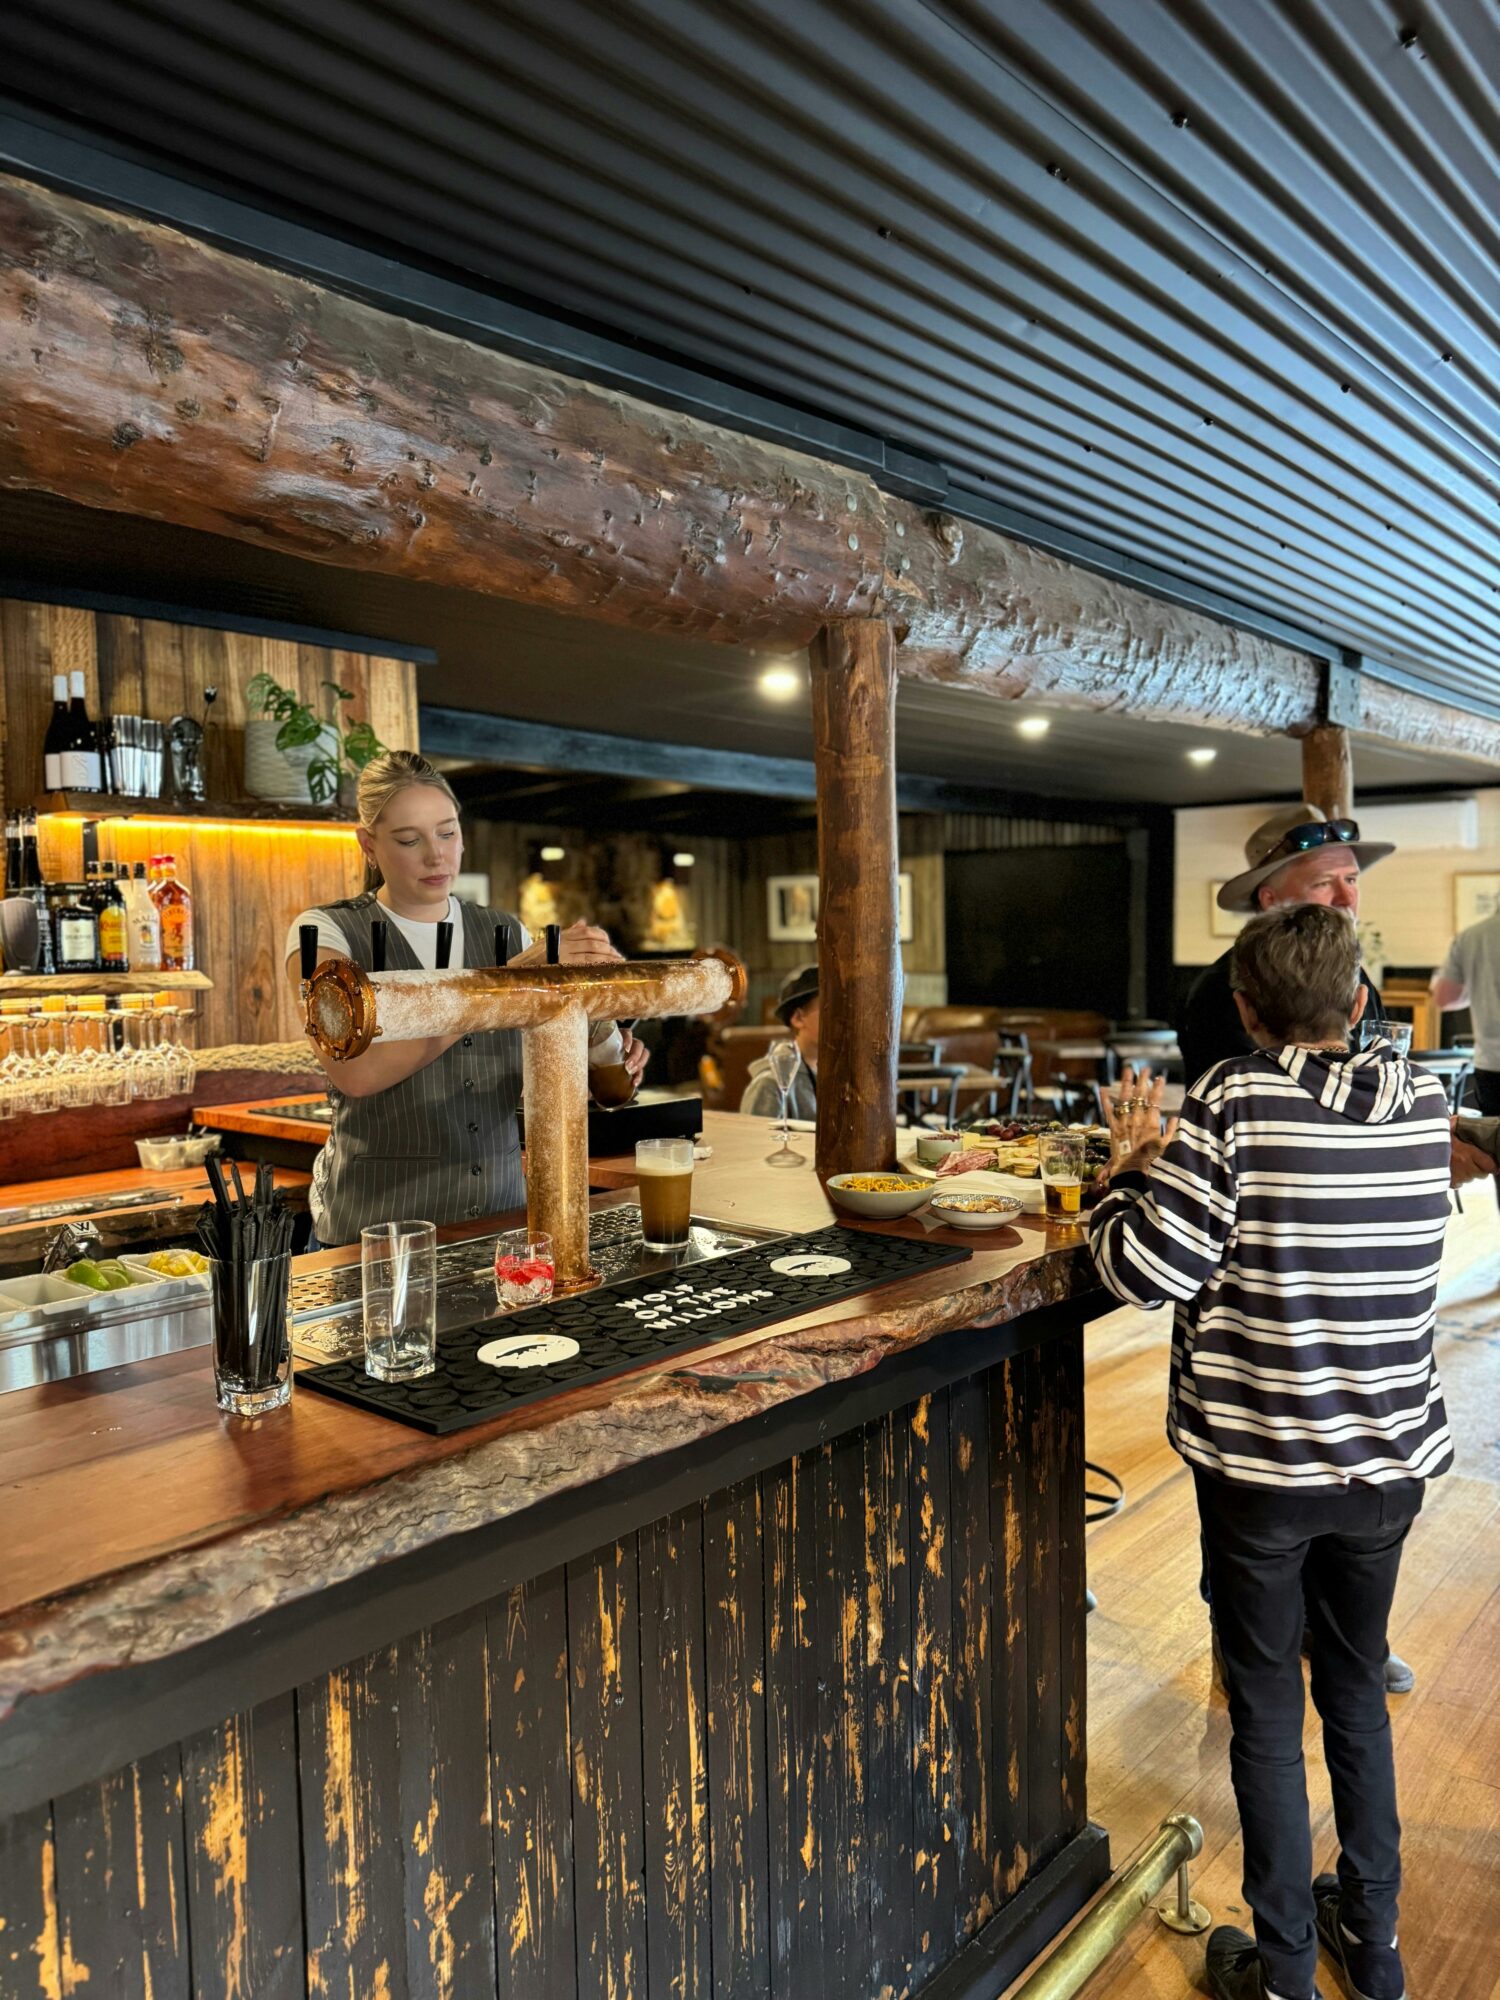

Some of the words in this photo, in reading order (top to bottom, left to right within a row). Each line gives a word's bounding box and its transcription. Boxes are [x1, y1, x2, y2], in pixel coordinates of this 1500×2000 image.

[70, 1221, 90, 1232] W
[615, 1284, 694, 1310] WOLF
[634, 1304, 673, 1320] OF
[676, 1287, 737, 1305] THE
[644, 1289, 774, 1330] WILLOWS
